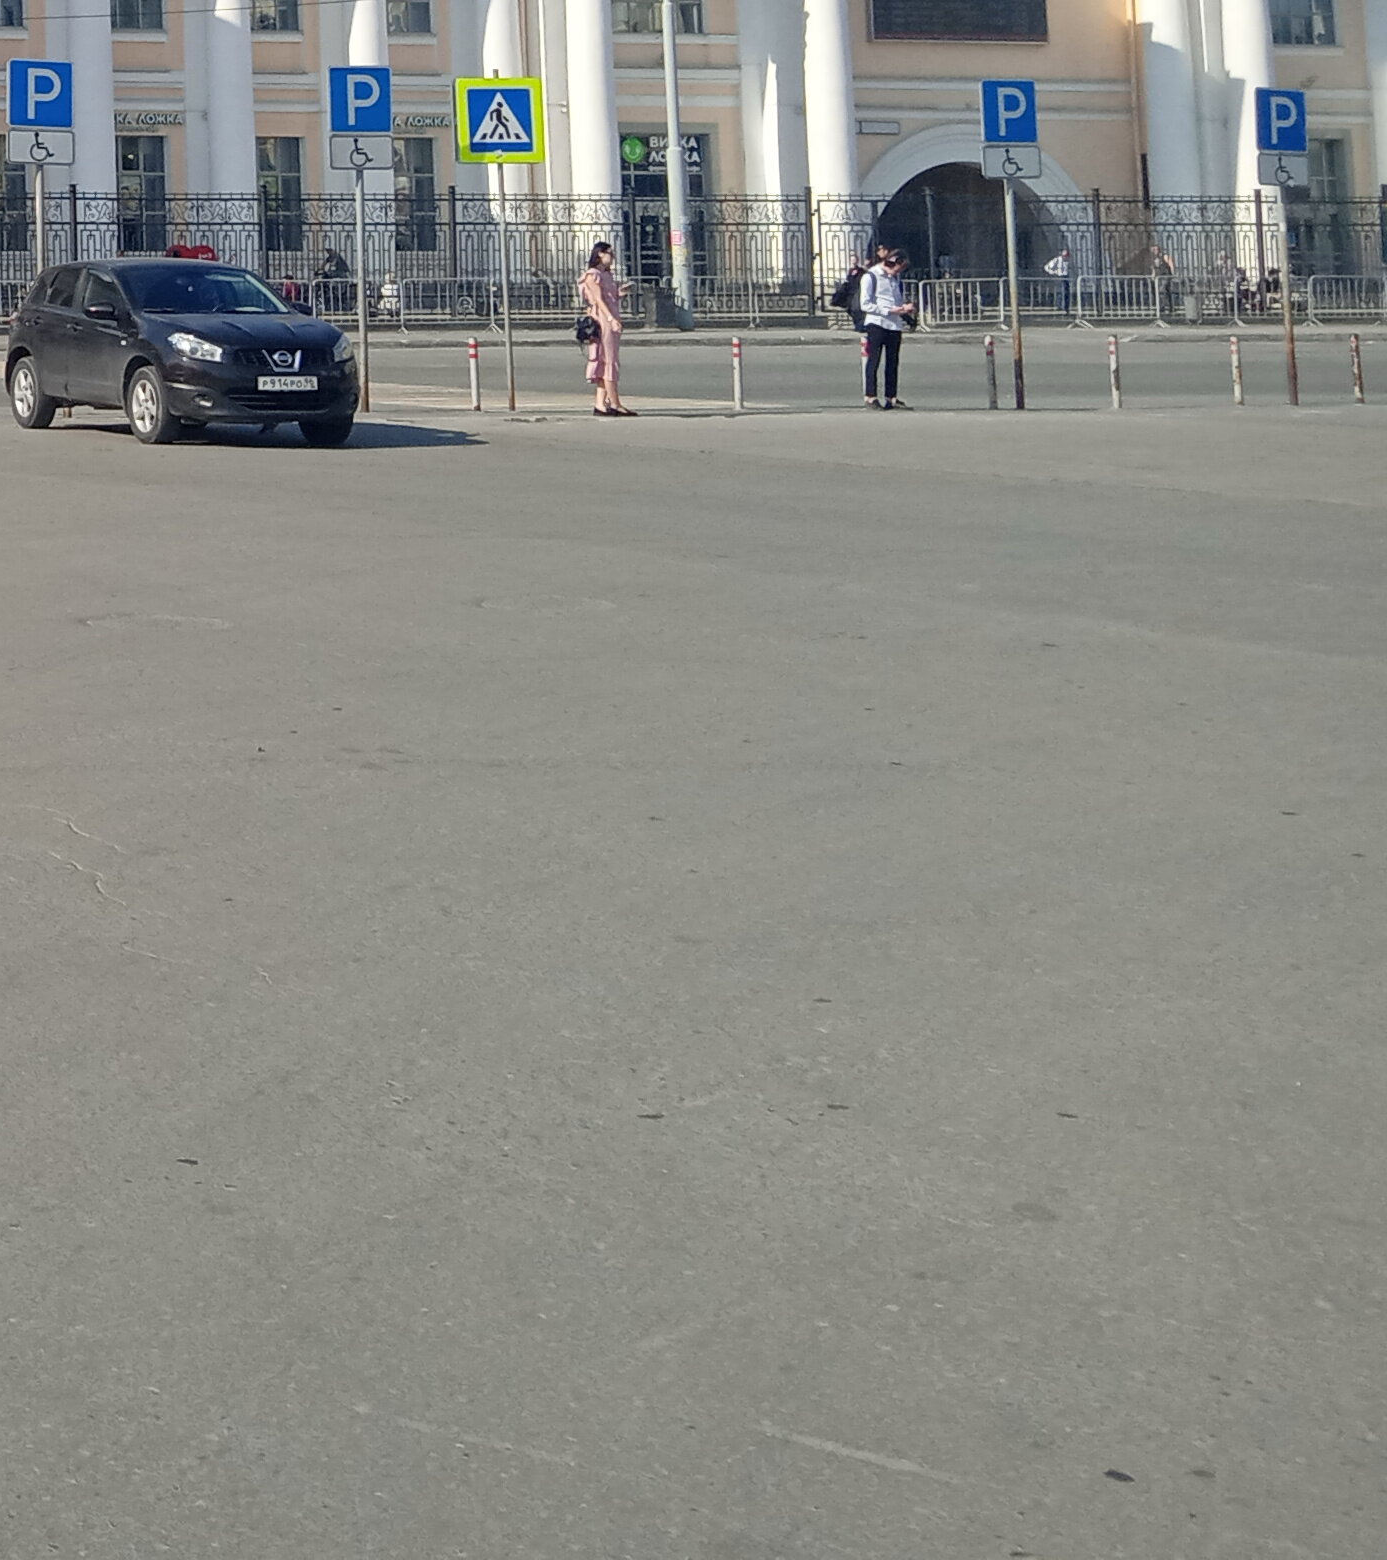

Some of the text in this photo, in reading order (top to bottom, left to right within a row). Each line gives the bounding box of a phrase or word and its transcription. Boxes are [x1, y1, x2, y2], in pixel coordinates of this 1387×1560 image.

[27, 67, 61, 120] P
[347, 74, 380, 126] P
[137, 112, 184, 125] ЛОЖКА
[406, 115, 451, 127] ЛОЖКА
[997, 87, 1027, 137] P
[1270, 96, 1297, 145] P
[649, 136, 698, 148] ВИКА
[649, 151, 700, 162] ЛОКА
